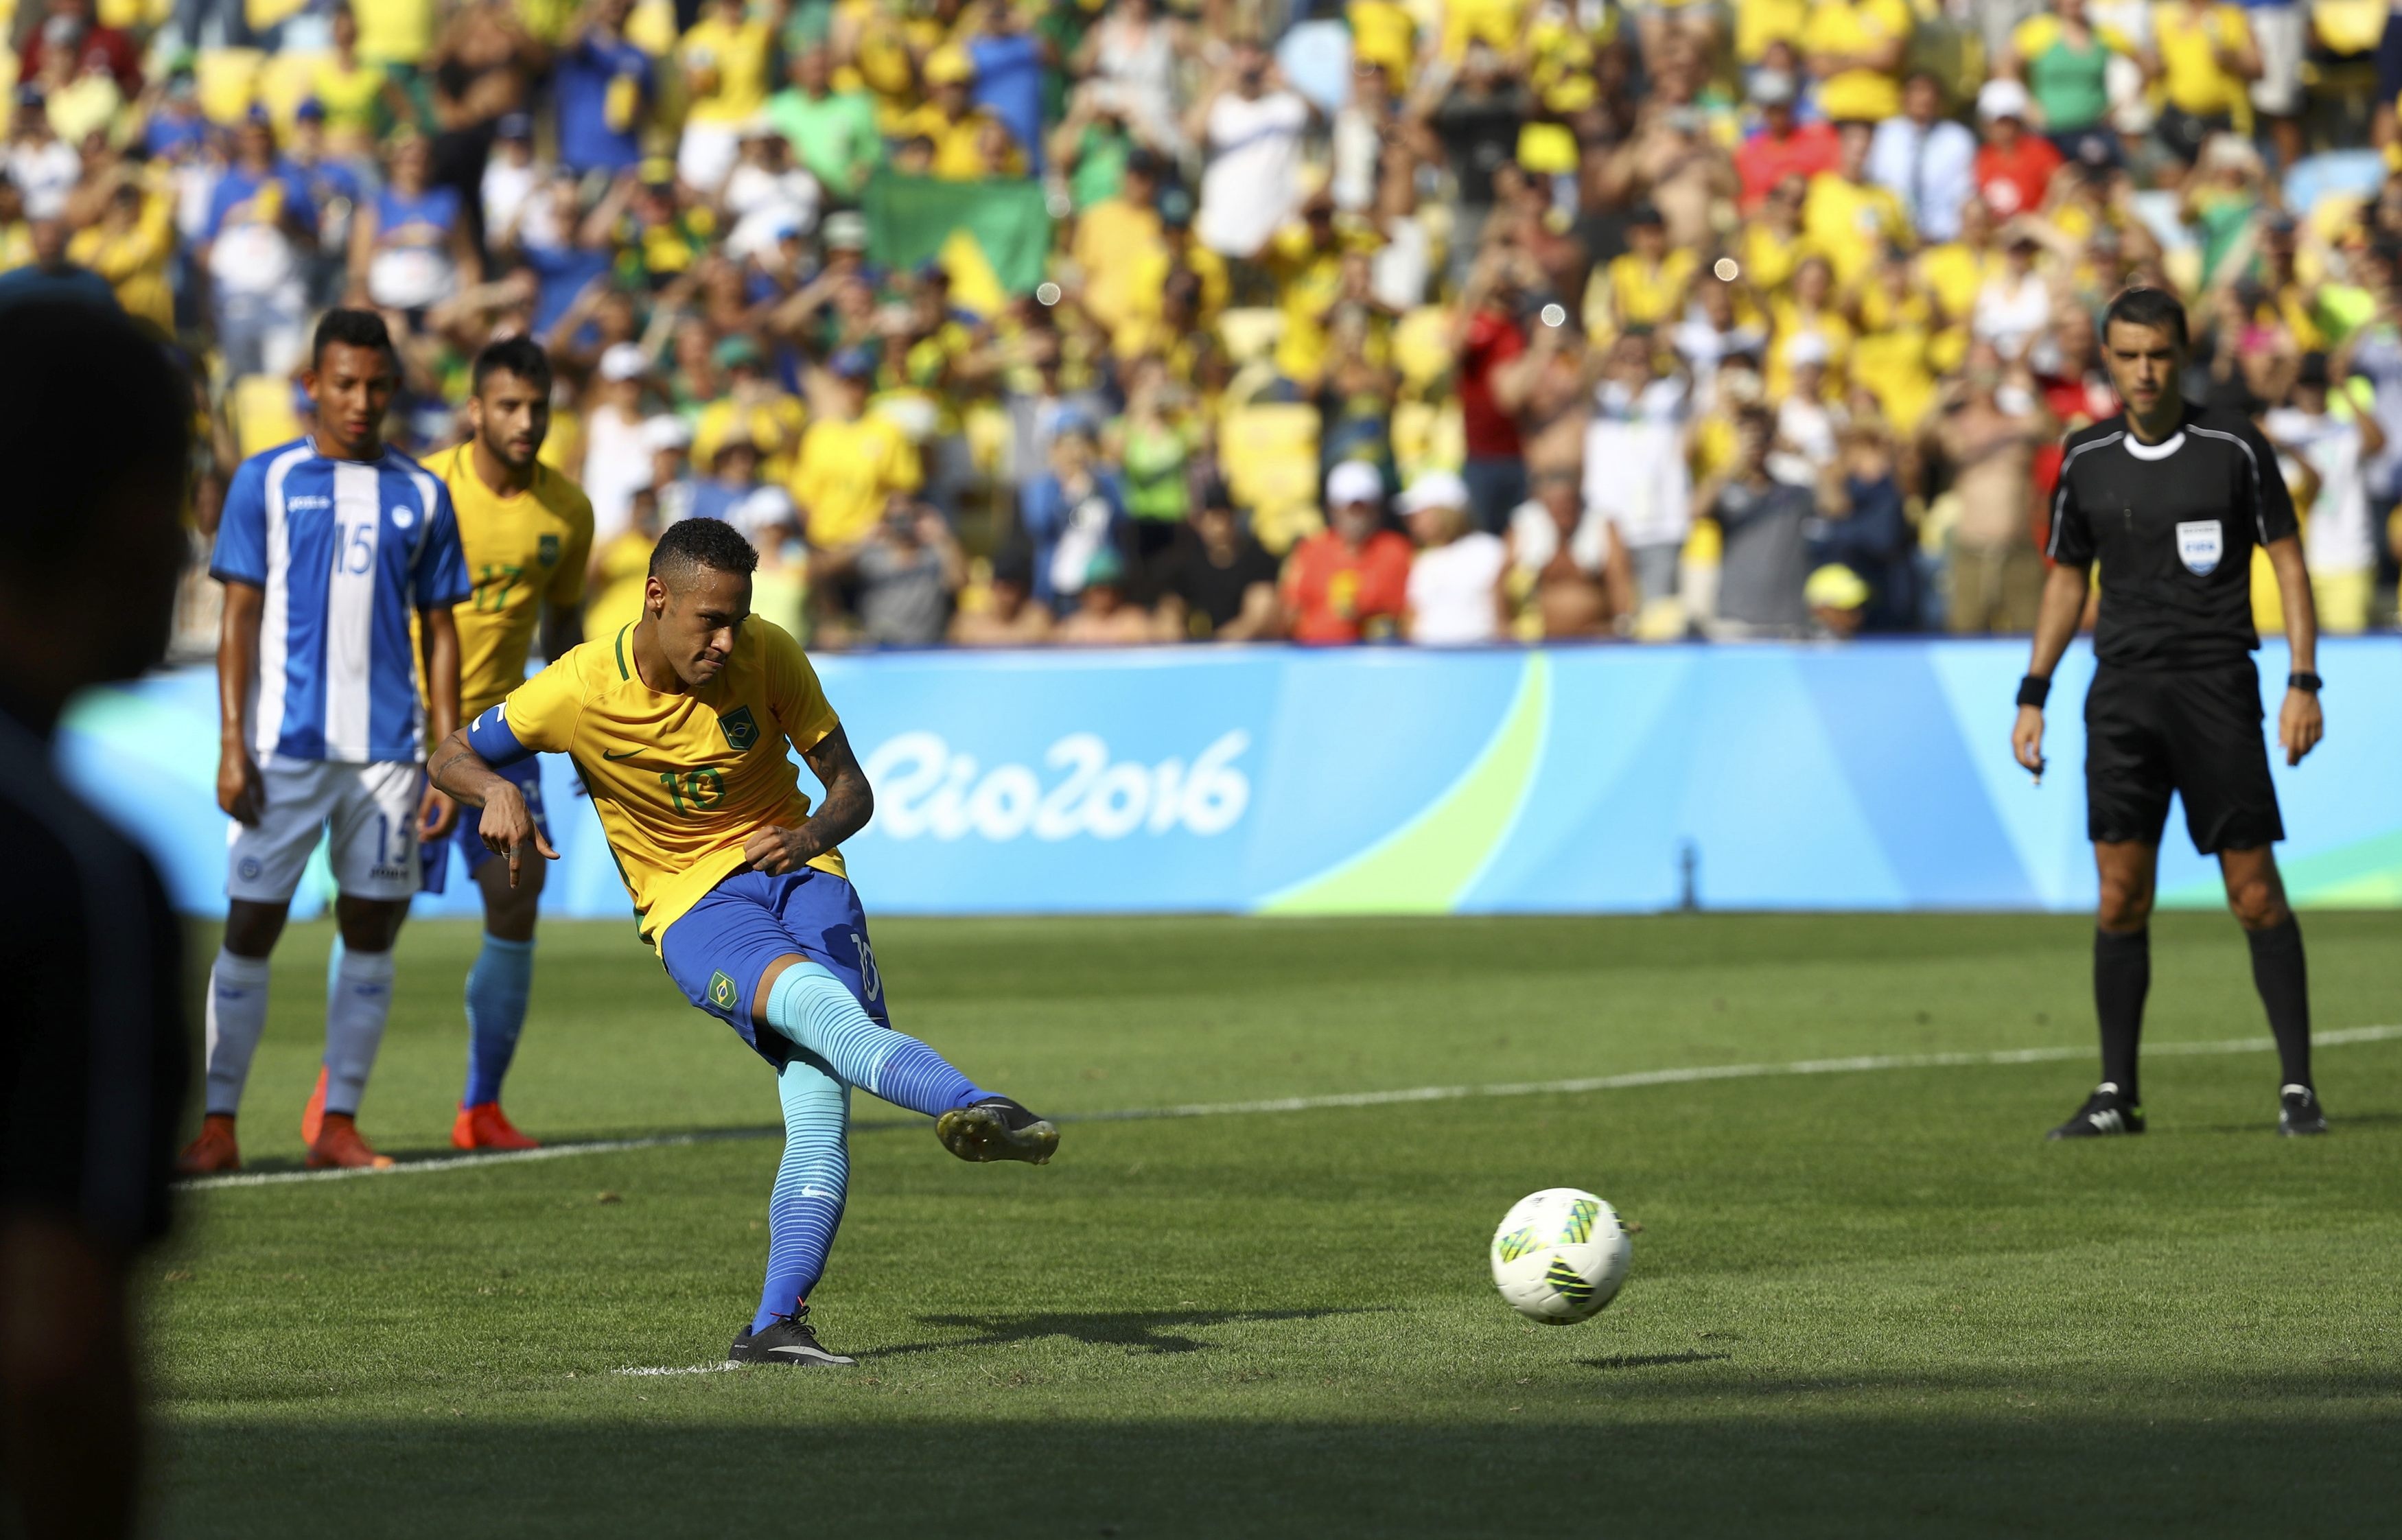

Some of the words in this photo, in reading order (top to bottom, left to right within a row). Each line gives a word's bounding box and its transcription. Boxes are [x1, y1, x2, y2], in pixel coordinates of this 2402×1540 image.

[336, 523, 373, 574] 15
[480, 563, 524, 613] 17
[660, 766, 726, 816] 10
[850, 933, 879, 1002] 10
